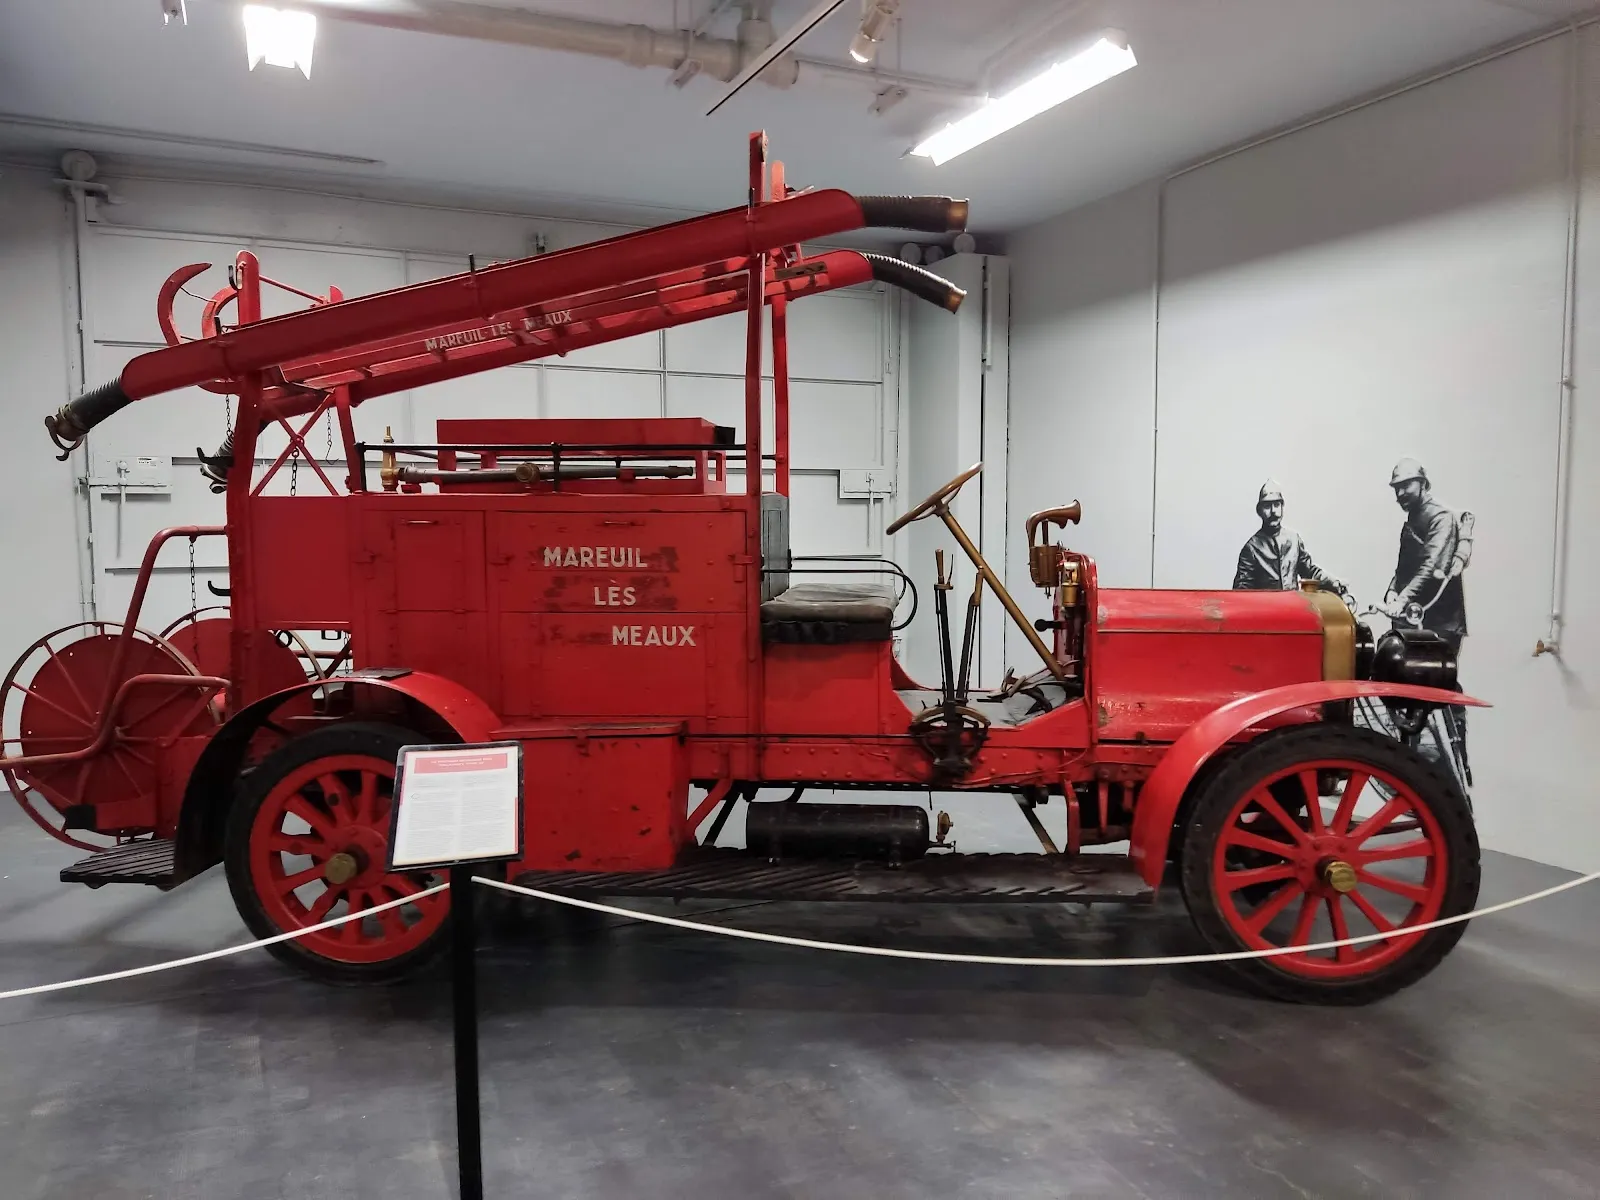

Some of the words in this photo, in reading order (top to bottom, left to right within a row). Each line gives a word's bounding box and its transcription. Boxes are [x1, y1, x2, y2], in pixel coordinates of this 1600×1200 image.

[425, 329, 485, 351] MAREUIL
[543, 546, 648, 568] MAREUIL
[593, 579, 637, 606] LÈS
[612, 625, 697, 647] MEAUX
